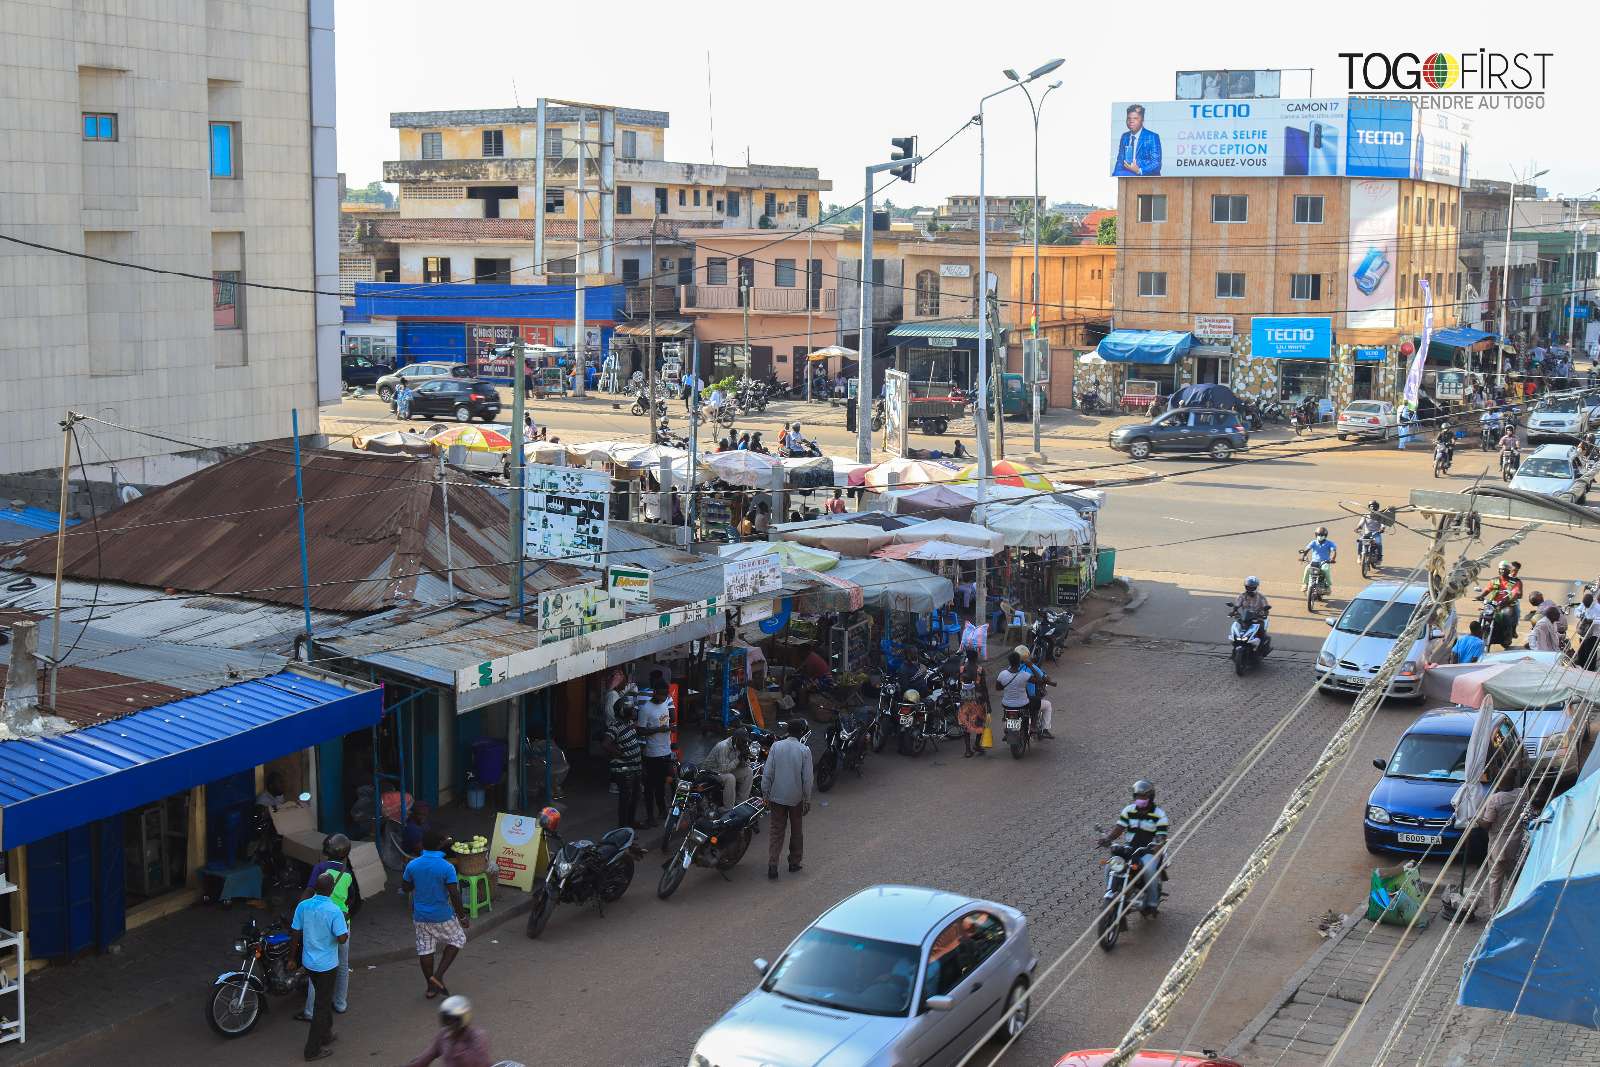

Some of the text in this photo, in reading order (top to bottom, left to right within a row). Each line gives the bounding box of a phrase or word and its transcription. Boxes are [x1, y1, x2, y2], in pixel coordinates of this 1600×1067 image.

[1189, 103, 1250, 118] TECNO
[1286, 102, 1340, 112] CAMON 17
[1176, 129, 1268, 140] CAMERA SELFIE
[1356, 129, 1404, 145] TECNO
[1176, 143, 1268, 155] D'EXCEPTION
[1176, 158, 1267, 167] DEMARQUEZ-VOUS
[1264, 328, 1314, 341] TECNO
[1405, 834, 1426, 843] 6009
